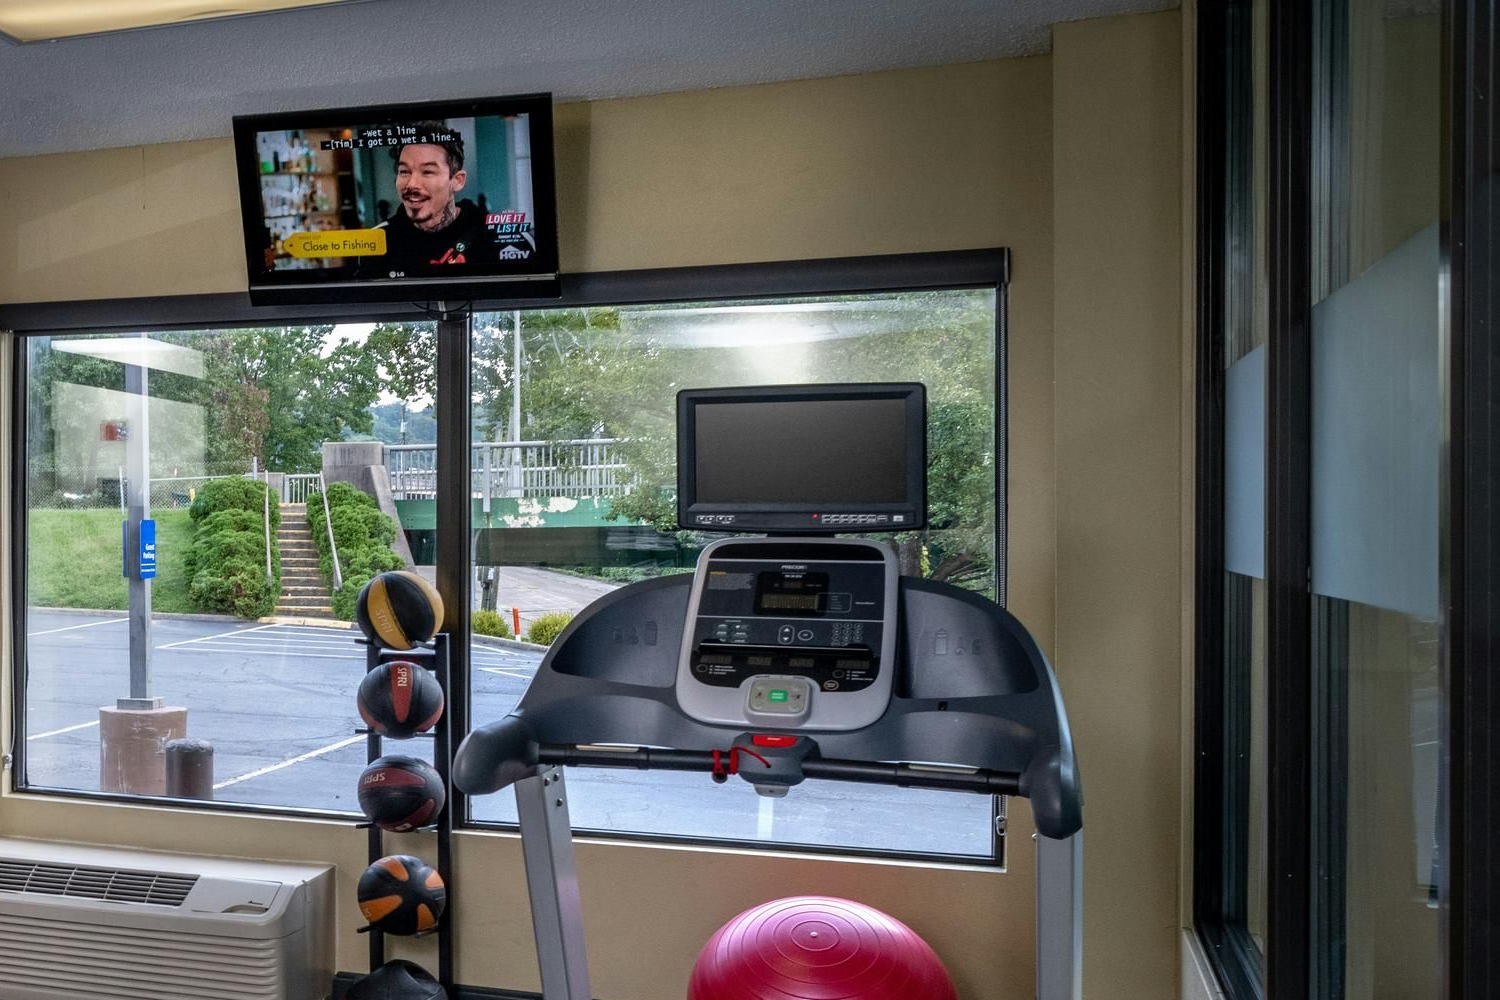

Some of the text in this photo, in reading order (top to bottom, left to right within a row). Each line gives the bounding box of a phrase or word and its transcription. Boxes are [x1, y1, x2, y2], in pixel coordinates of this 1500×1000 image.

[396, 126, 416, 135] line
[359, 139, 364, 147] I
[368, 138, 383, 148] got
[388, 137, 397, 145] to
[401, 136, 417, 144] wet
[431, 133, 455, 142] line.
[488, 214, 524, 224] LOVE IT
[496, 224, 518, 233] LIST
[519, 223, 529, 232] IT
[302, 240, 376, 252] Close to Fishing
[499, 249, 530, 260] HGTV
[375, 609, 394, 634] SPRI
[397, 666, 408, 687] SPRI
[364, 772, 386, 785] SPRI
